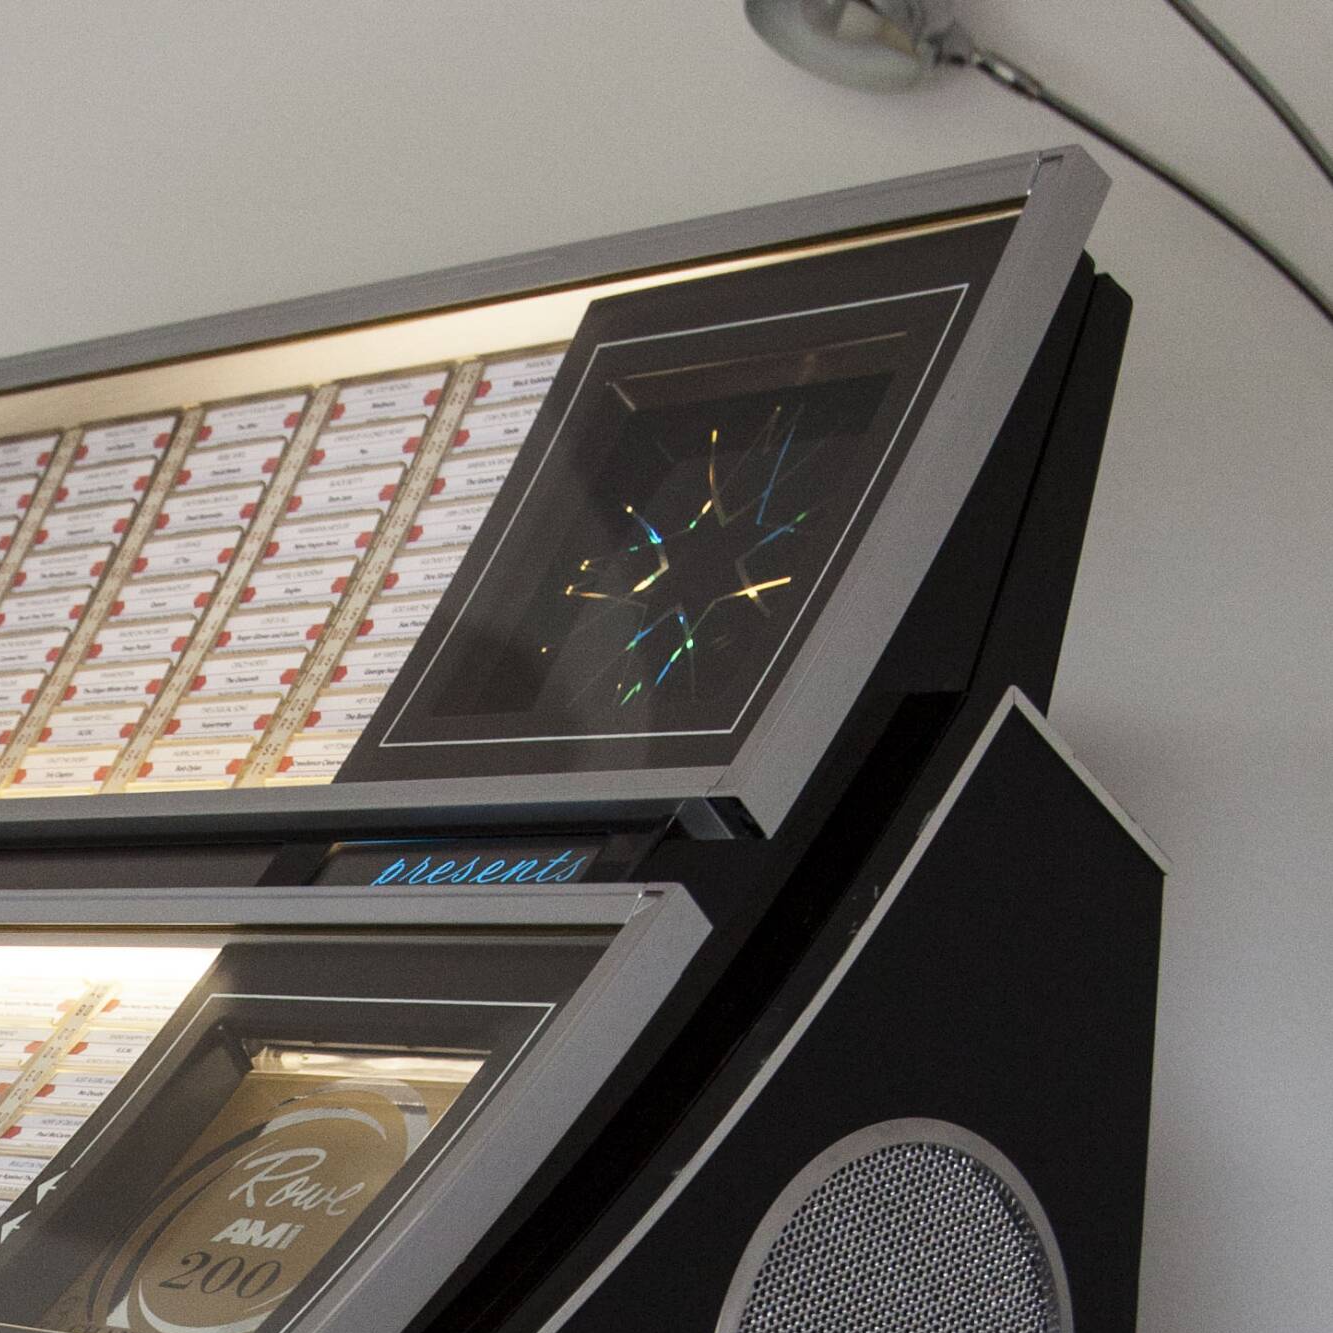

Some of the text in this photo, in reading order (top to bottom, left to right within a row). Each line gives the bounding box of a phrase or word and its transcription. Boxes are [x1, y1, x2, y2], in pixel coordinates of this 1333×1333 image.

[369, 850, 588, 887] presents
[229, 1147, 365, 1216] Rowe
[159, 1251, 282, 1299] 200
